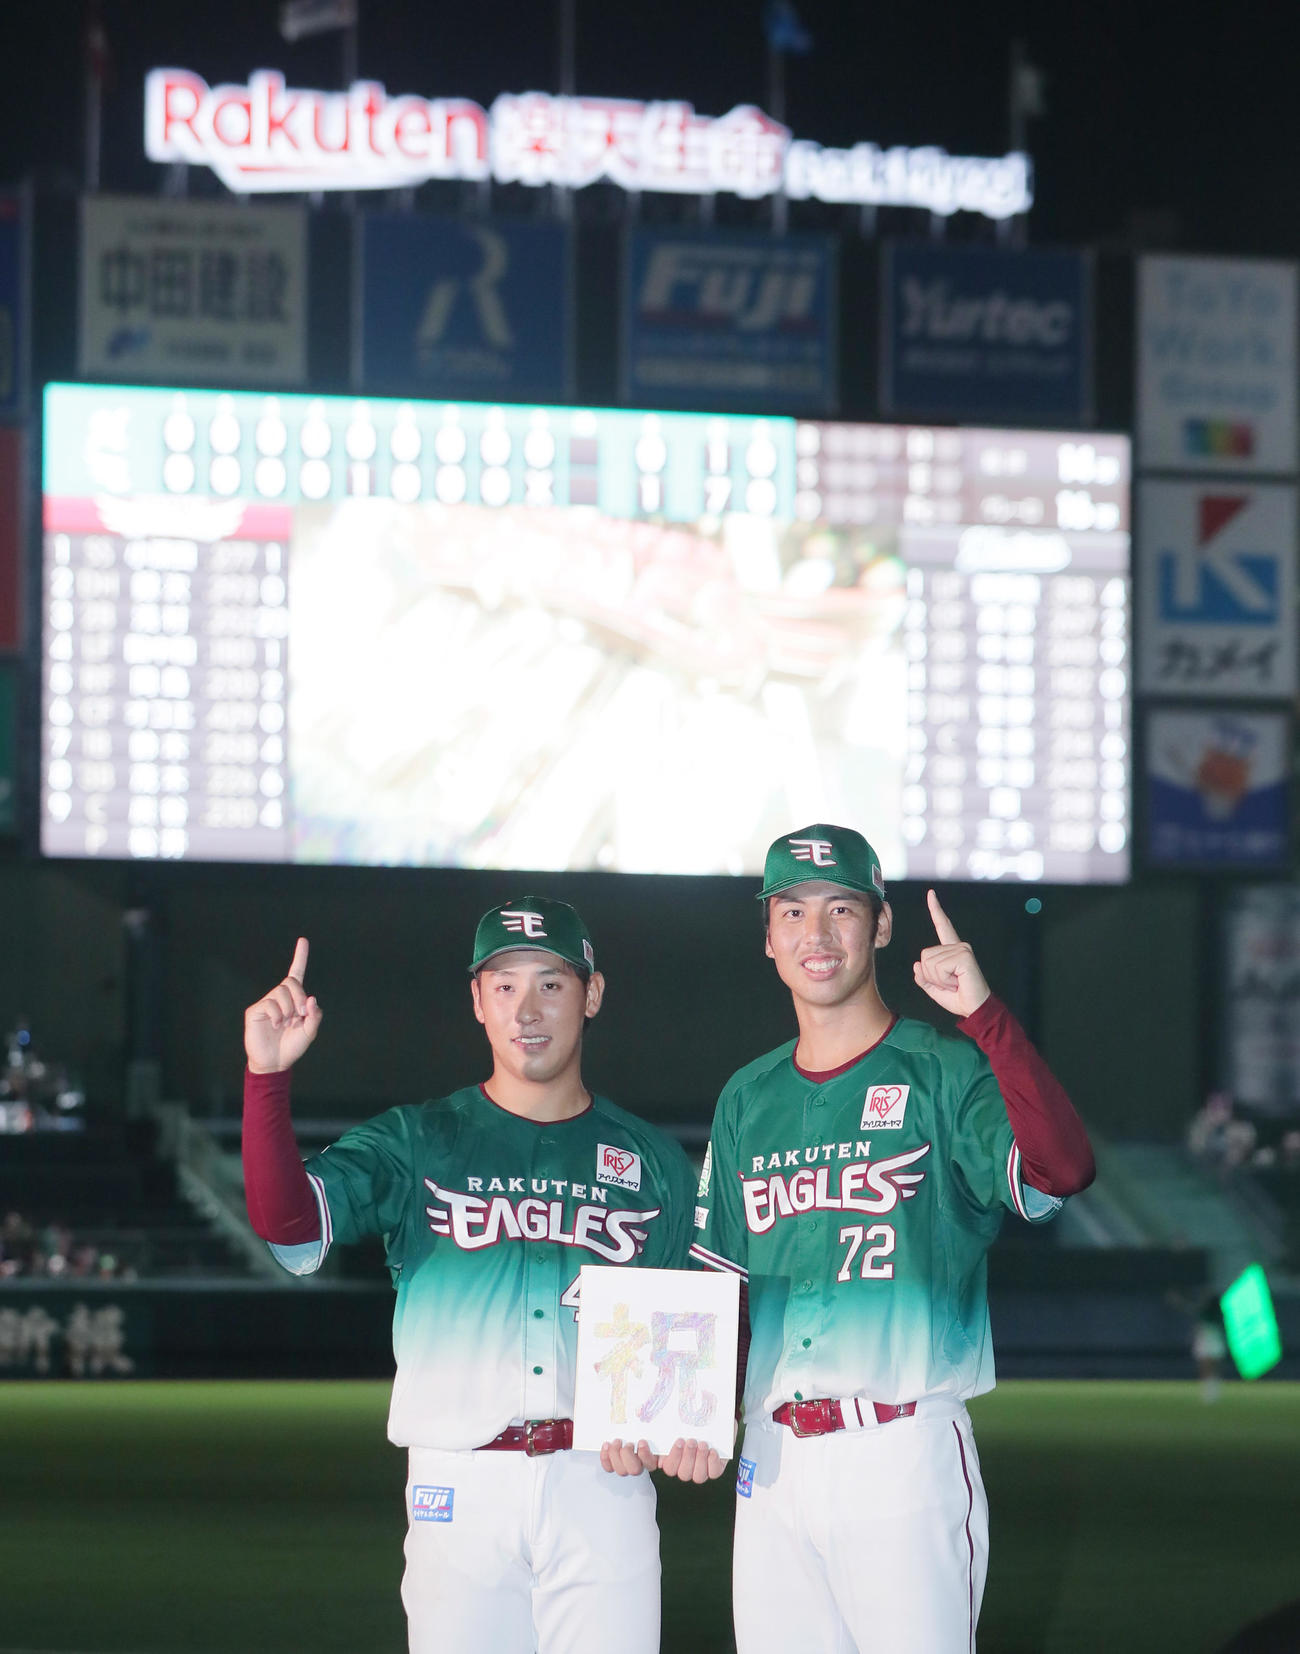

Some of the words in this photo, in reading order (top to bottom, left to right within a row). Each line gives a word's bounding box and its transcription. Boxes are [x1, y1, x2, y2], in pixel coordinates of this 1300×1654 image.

[152, 69, 488, 172] Rakuten
[640, 244, 820, 331] Fuji
[899, 273, 1073, 347] Yurtec
[1158, 637, 1281, 682] カメイ
[861, 1119, 903, 1129] アイリスオーヤマ
[597, 1173, 639, 1190] アイリスオーヤマ
[752, 1140, 872, 1173] RAKUTEN
[467, 1176, 609, 1203] RAKUTEN
[737, 1141, 932, 1235] EAGLES
[424, 1176, 661, 1265] EAGLES
[837, 1223, 897, 1283] 72
[593, 1302, 718, 1427] 祝
[414, 1487, 451, 1510] Fuji
